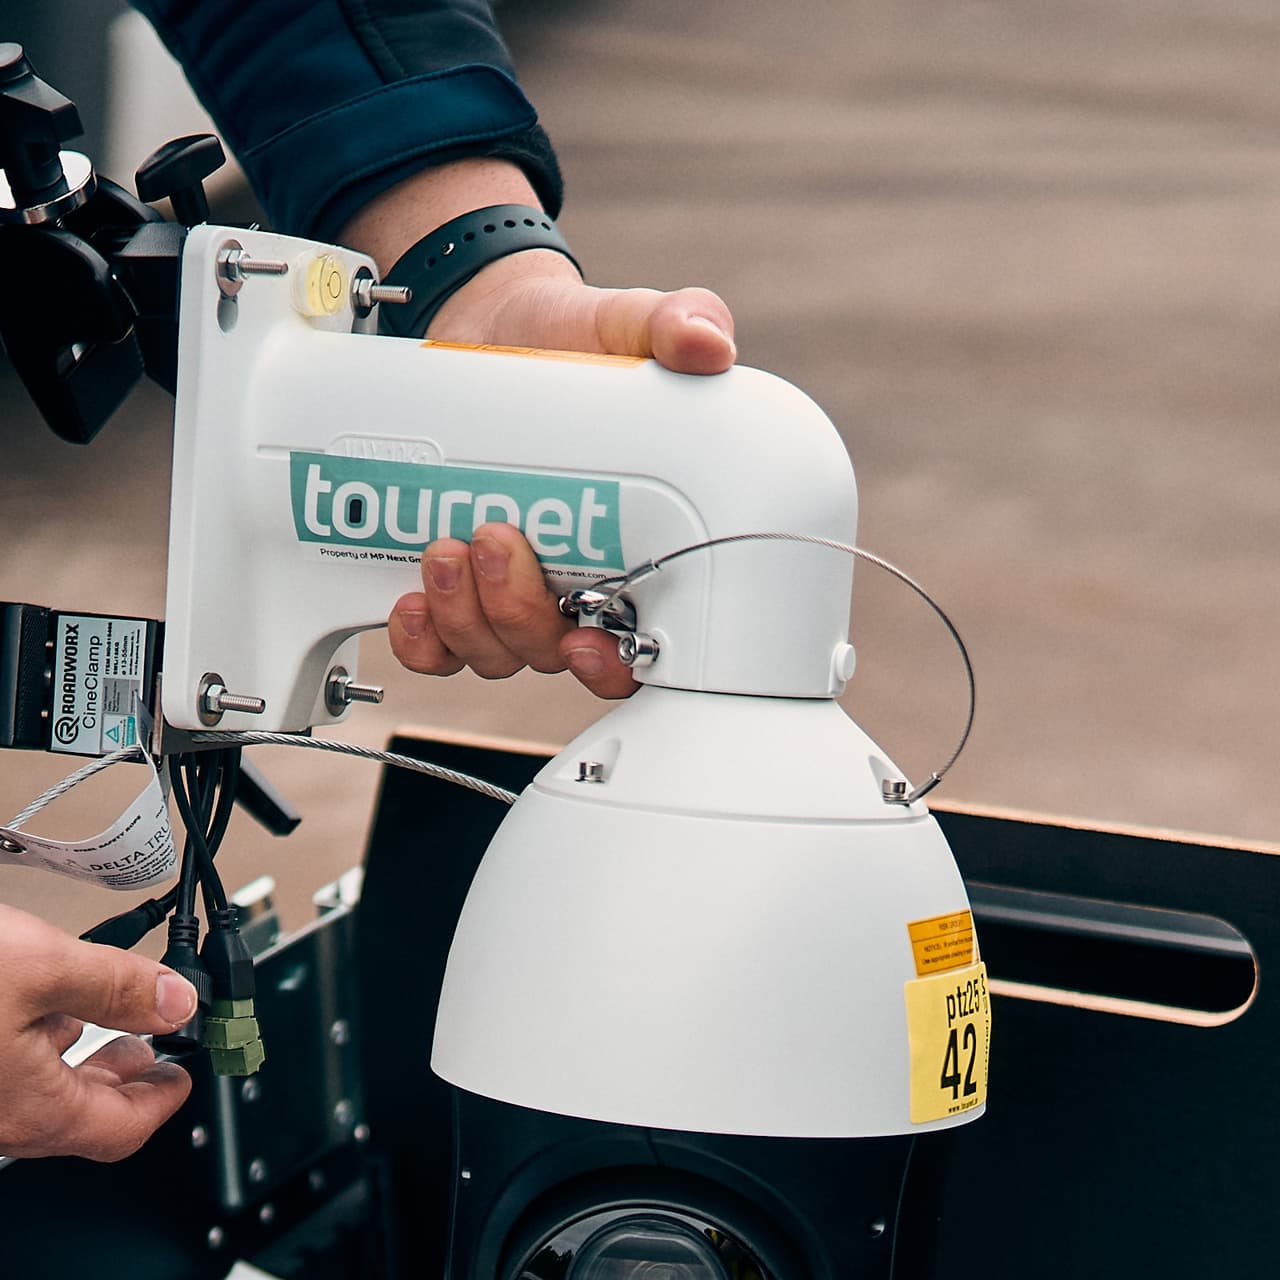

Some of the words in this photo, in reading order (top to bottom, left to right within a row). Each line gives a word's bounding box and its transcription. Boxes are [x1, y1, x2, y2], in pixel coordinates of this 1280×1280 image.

[304, 463, 608, 561] tournet
[320, 547, 359, 560] Property
[359, 551, 368, 559] of
[369, 552, 385, 560] MP
[386, 553, 408, 562] Next
[61, 623, 80, 715] ROADWORX
[82, 635, 103, 730] CineClamp
[89, 850, 145, 871] DELTA
[144, 821, 170, 849] TRU
[125, 814, 142, 832] ROPE
[946, 979, 980, 1028] ptz25
[940, 1022, 977, 1101] 42
